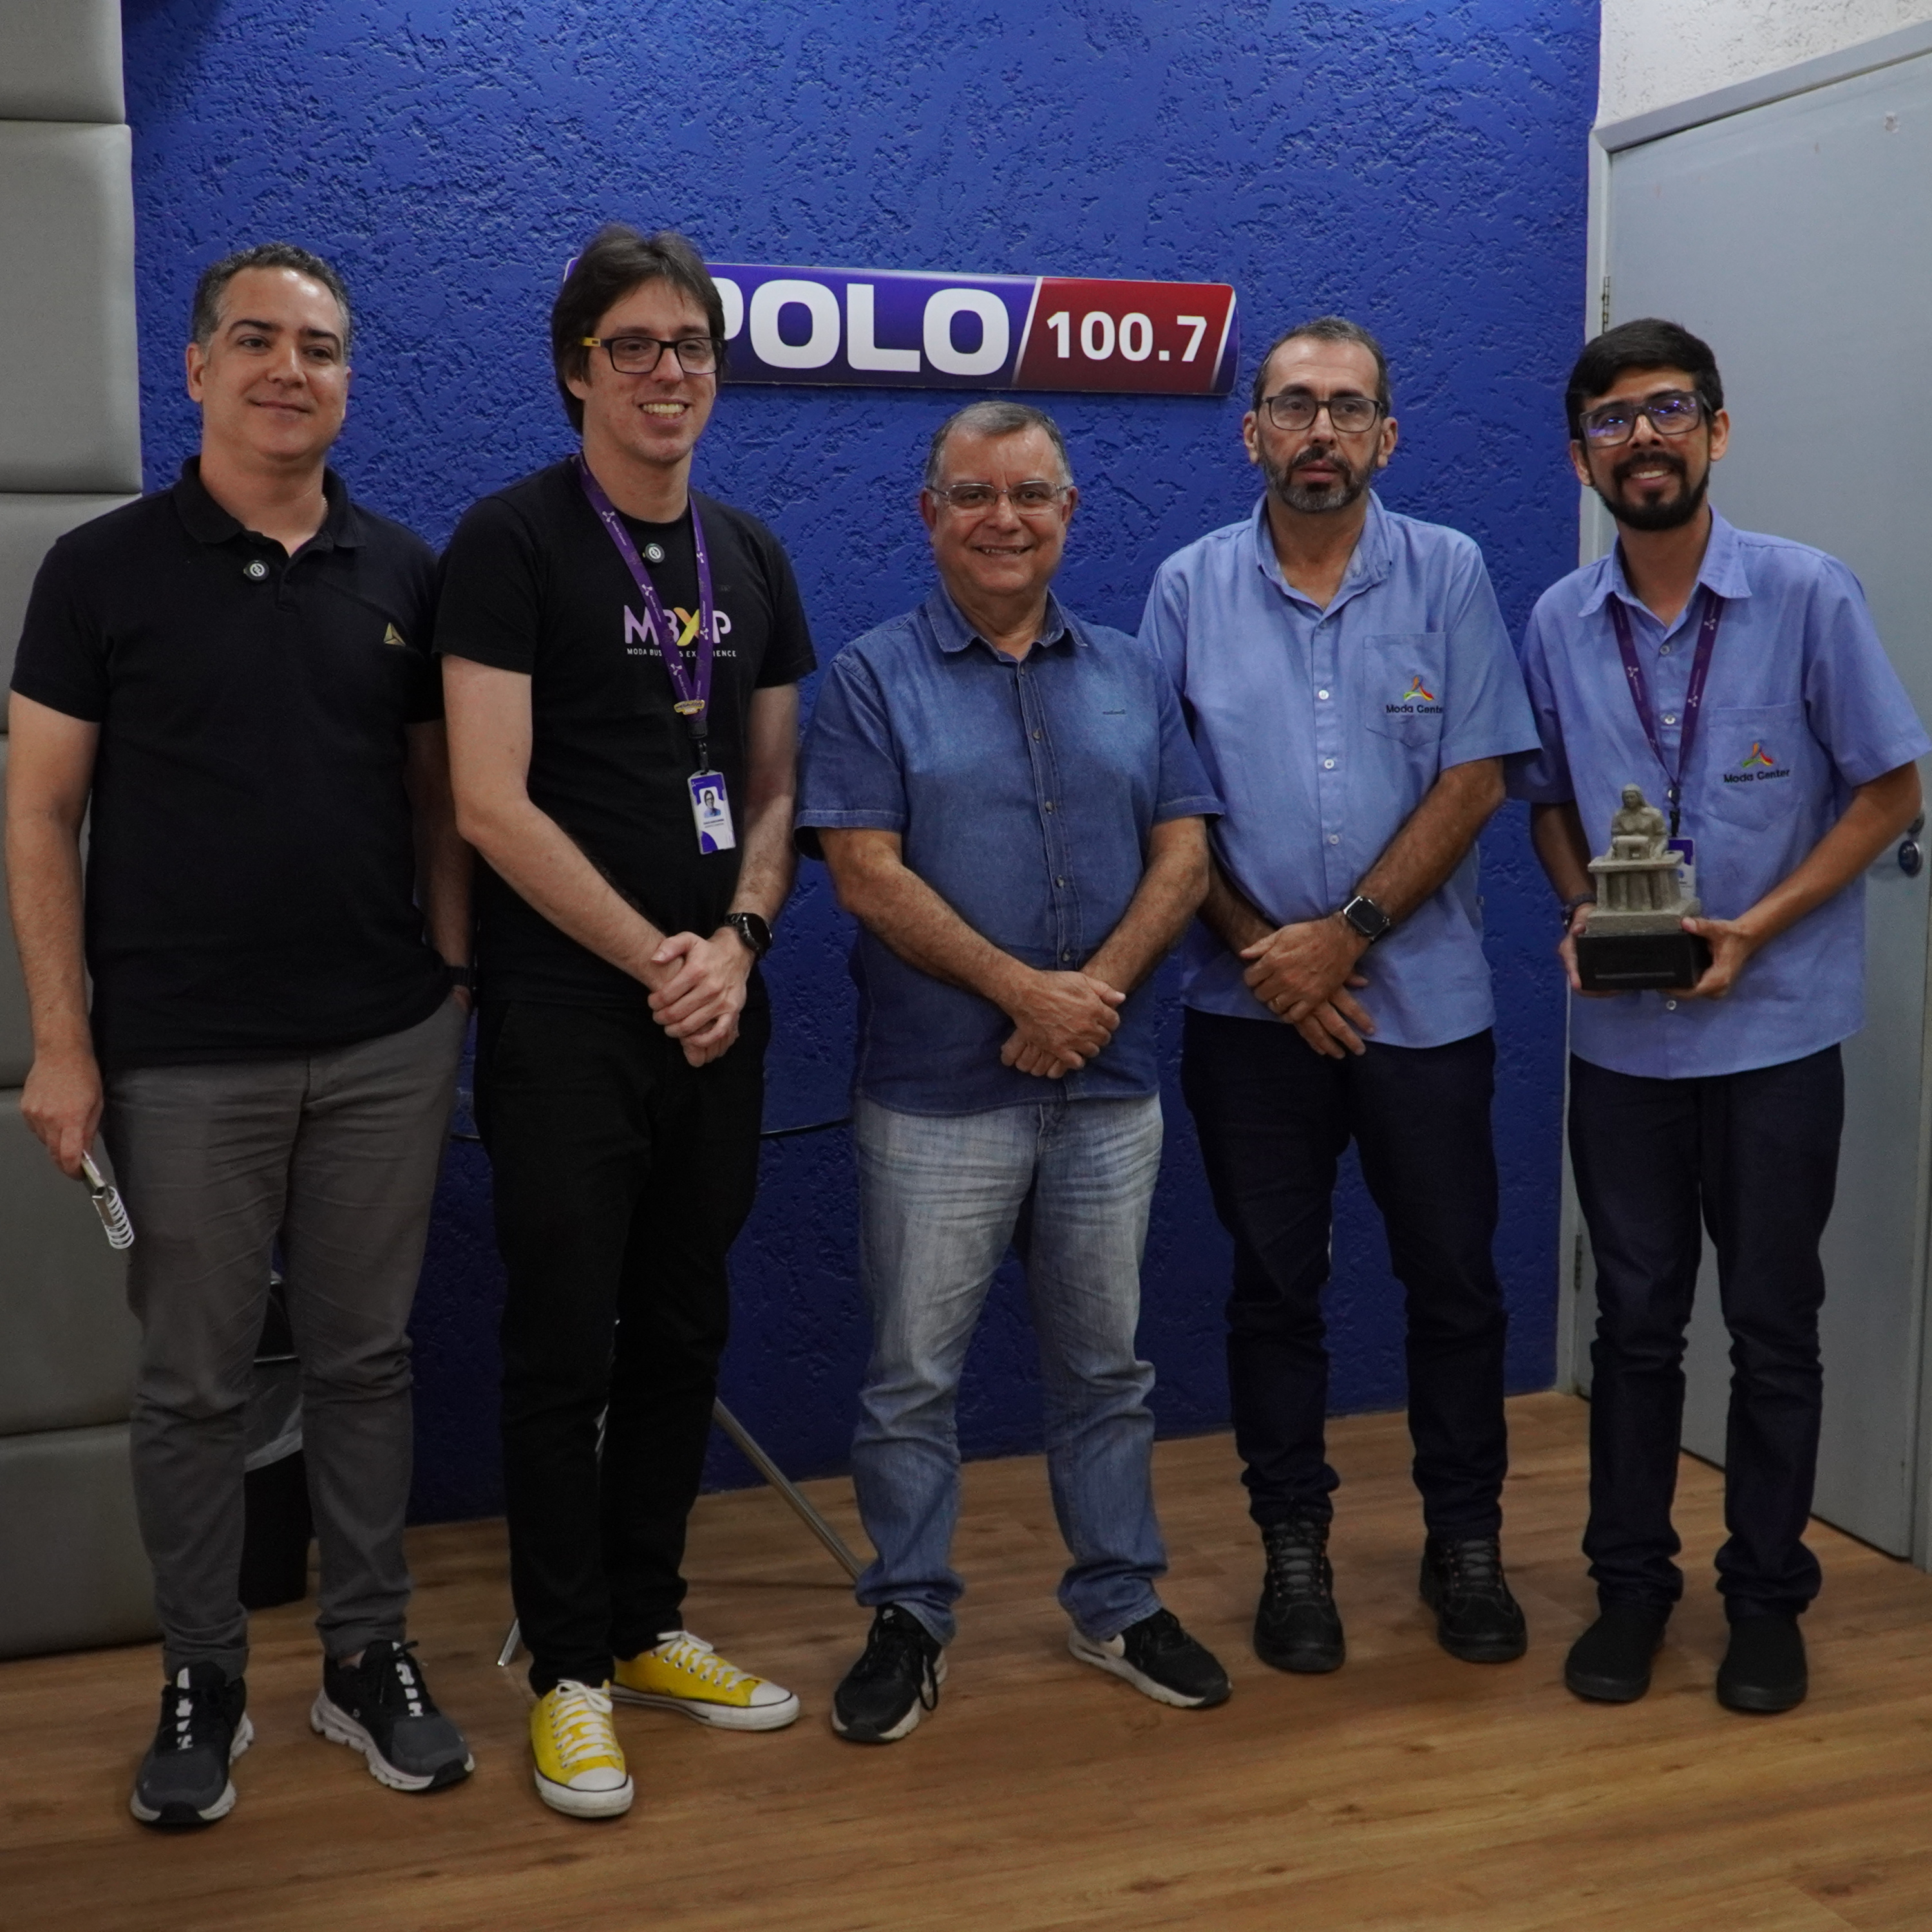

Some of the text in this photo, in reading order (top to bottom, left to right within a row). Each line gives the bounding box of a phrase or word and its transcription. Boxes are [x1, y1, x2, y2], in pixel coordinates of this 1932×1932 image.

[1046, 310, 1208, 363] 100.7
[650, 649, 683, 658] BUSS
[1386, 704, 1443, 714] Moda Cent
[1723, 769, 1790, 784] Moda Center
